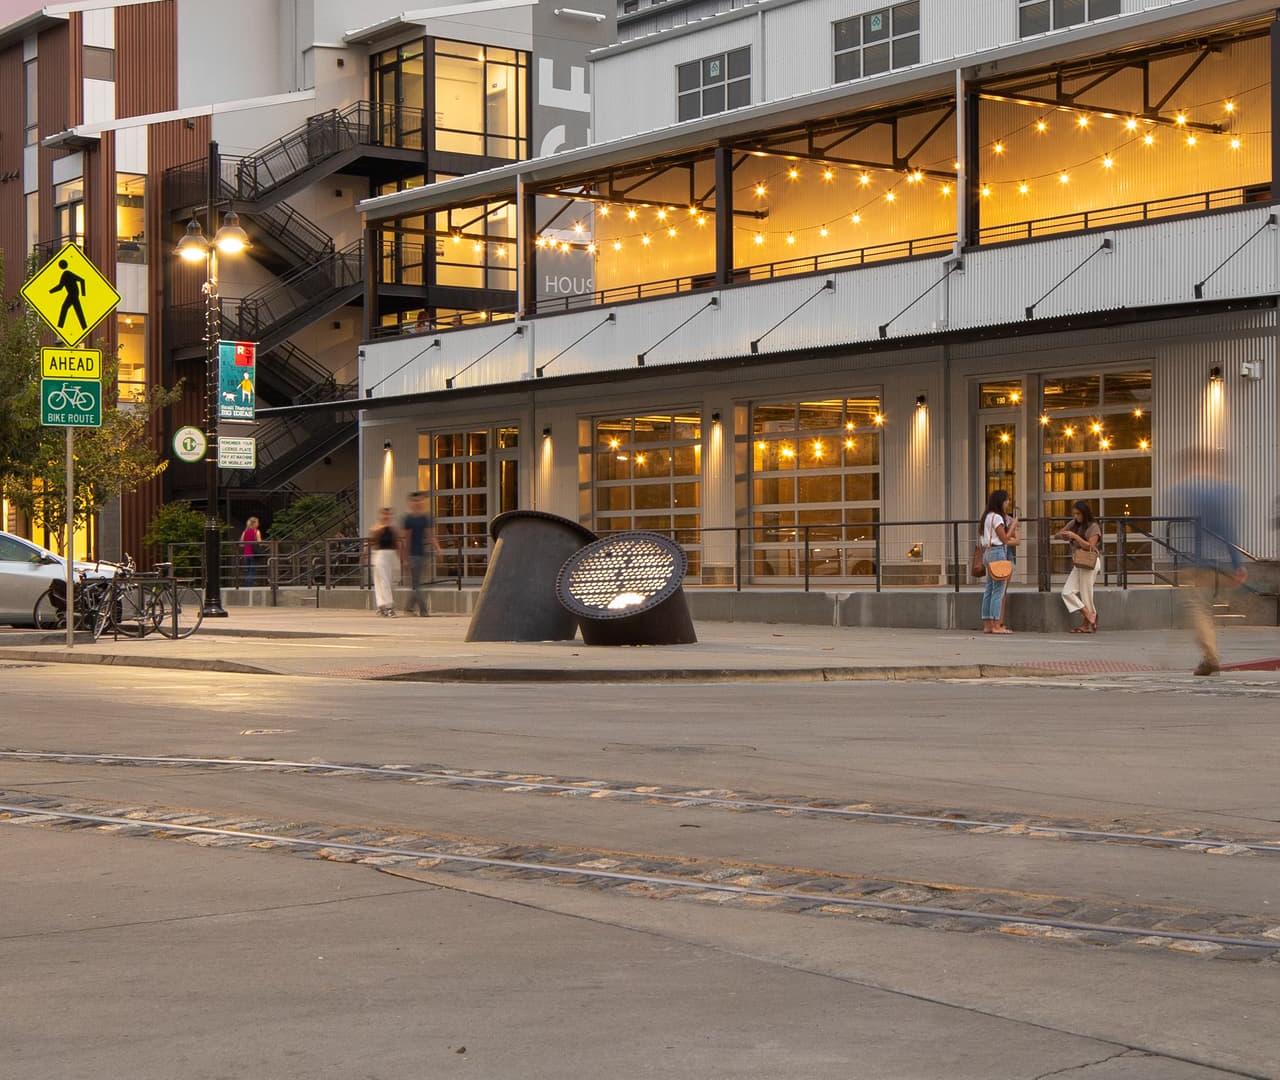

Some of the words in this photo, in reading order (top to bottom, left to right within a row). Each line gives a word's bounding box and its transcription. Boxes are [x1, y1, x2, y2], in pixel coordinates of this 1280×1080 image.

[49, 356, 94, 372] AHEAD
[47, 412, 66, 423] BIKE
[68, 413, 95, 424] ROUTE
